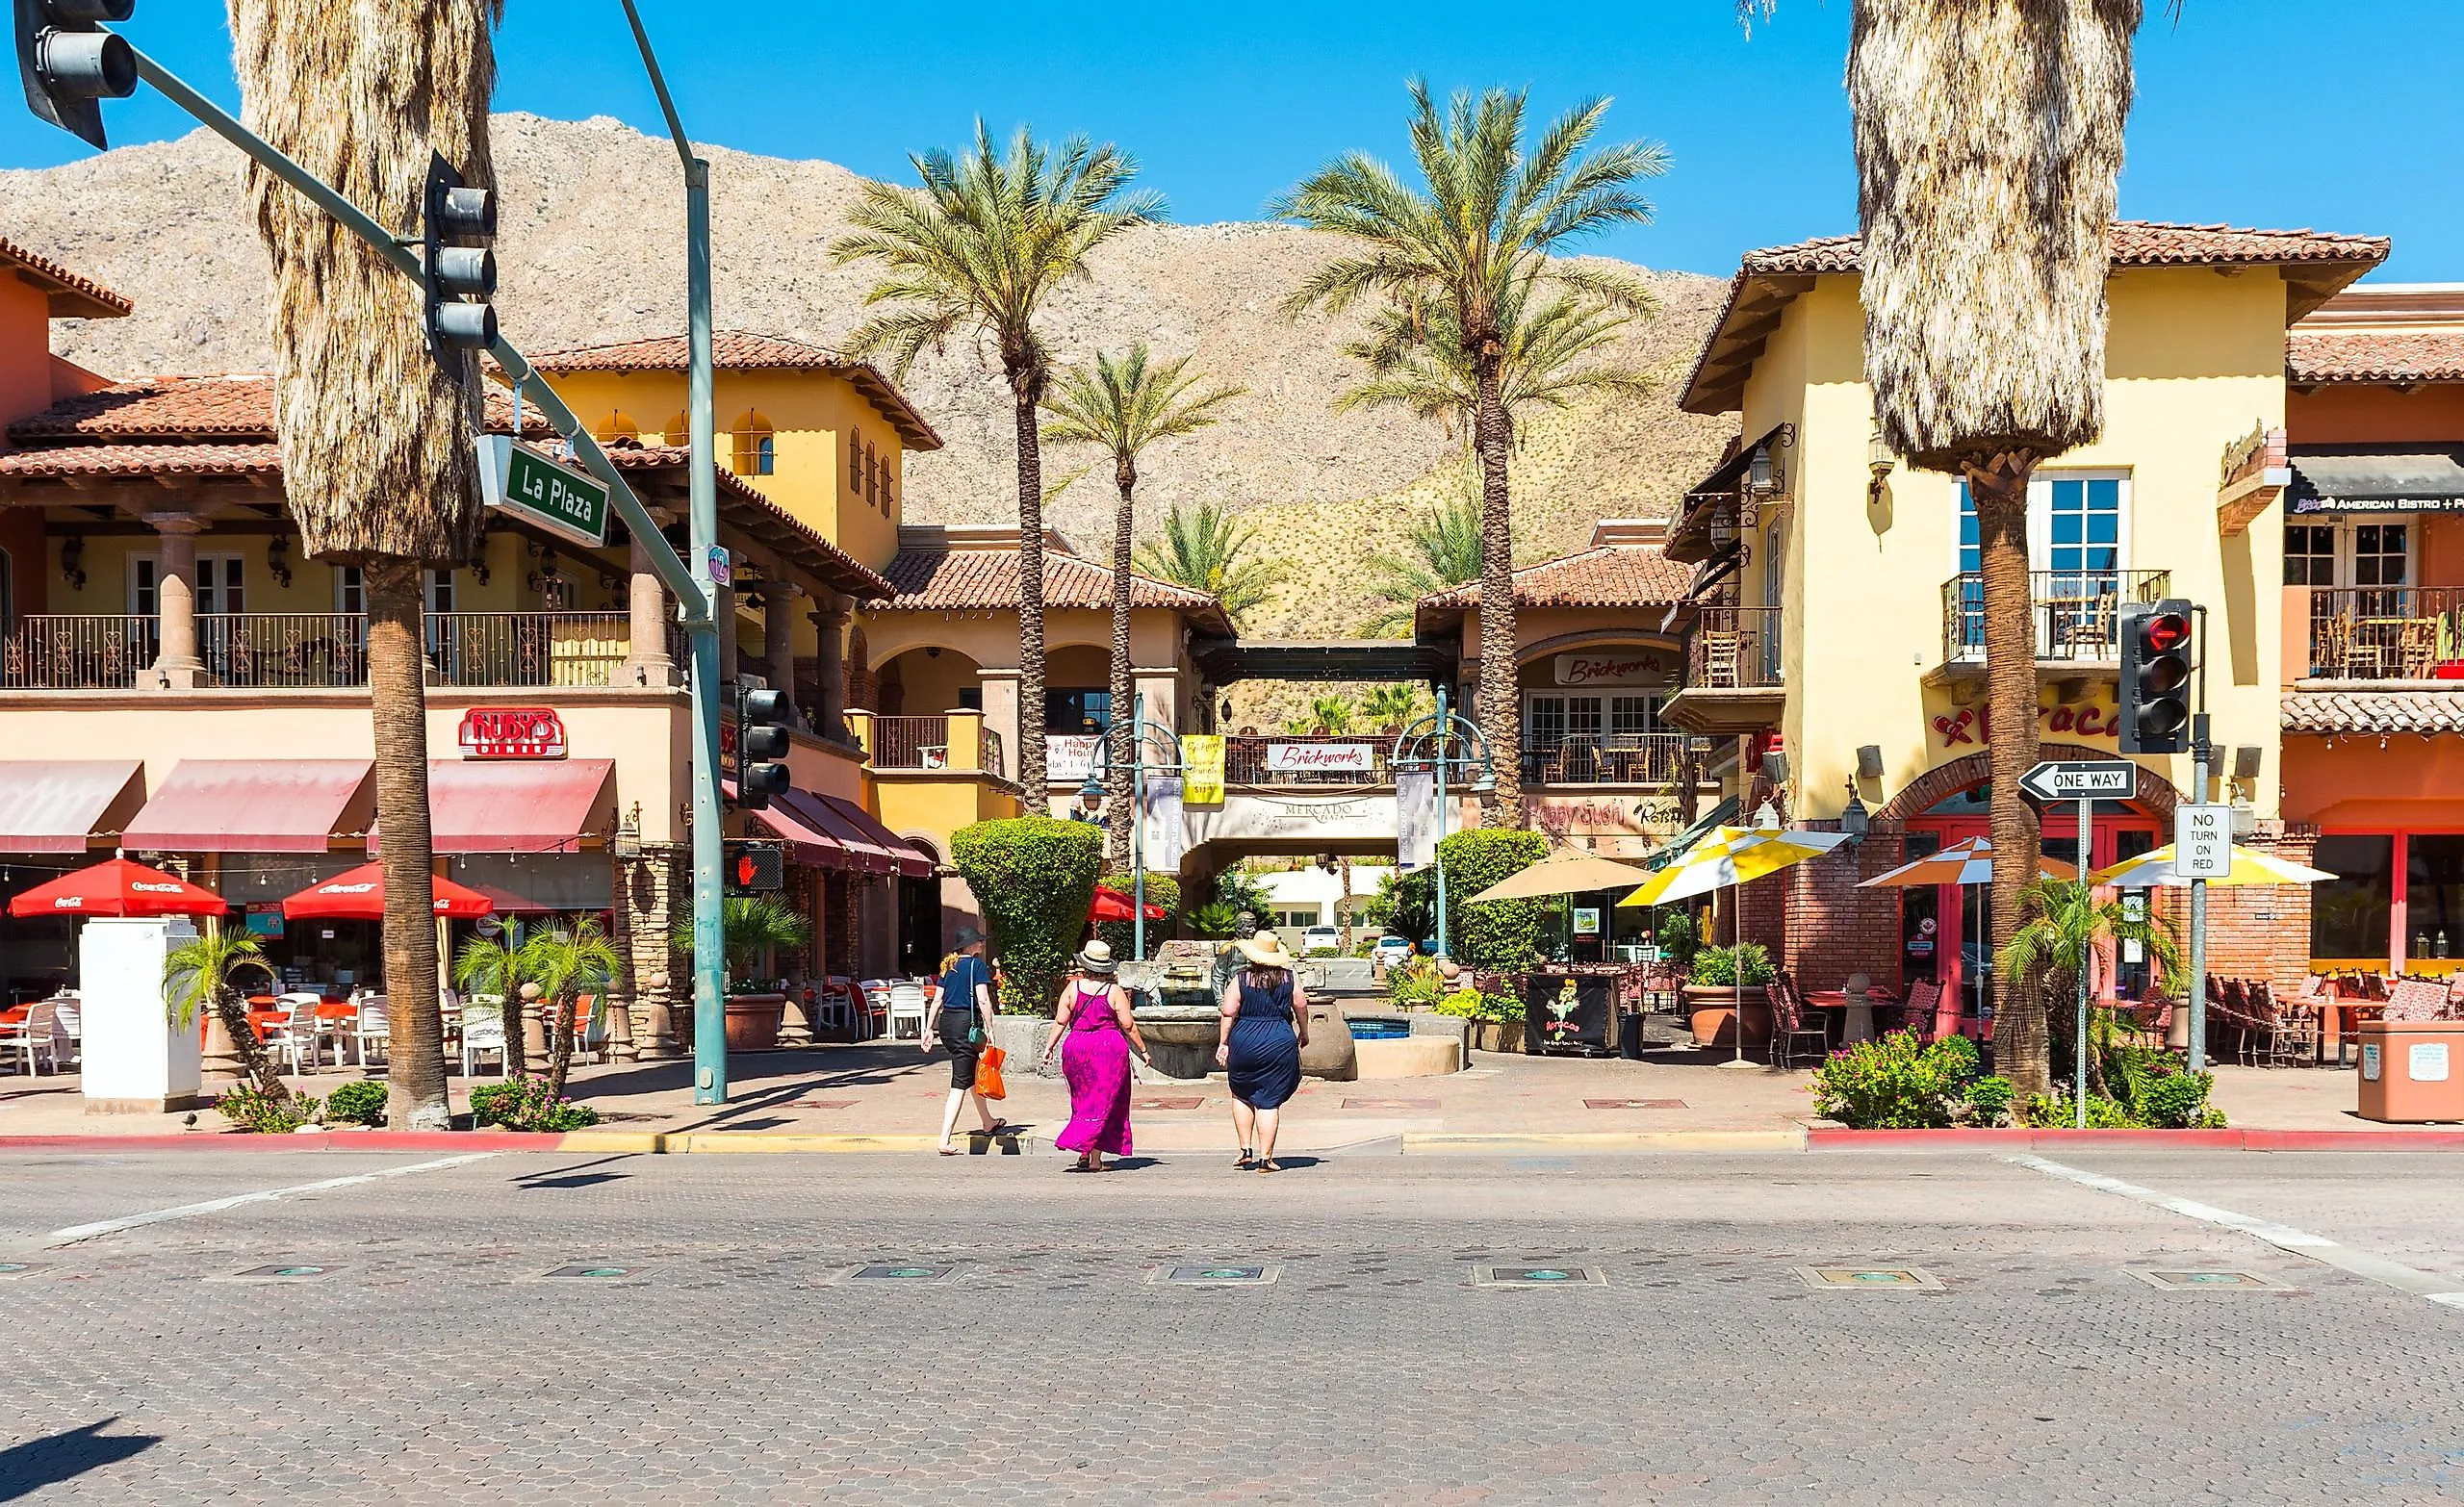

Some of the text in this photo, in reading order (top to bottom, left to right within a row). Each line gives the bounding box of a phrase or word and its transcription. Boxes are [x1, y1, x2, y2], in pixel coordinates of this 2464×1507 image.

[522, 465, 592, 523] La Plaza
[715, 552, 726, 577] 12
[1560, 654, 1660, 684] Brickworks
[481, 745, 542, 754] DINER
[1272, 746, 1363, 769] Brickworks
[2054, 773, 2122, 788] ONE WAY
[1285, 805, 1352, 816] MERCADO
[2193, 814, 2214, 827] NO
[2190, 830, 2218, 841] TURN
[2195, 845, 2211, 856] ON
[2193, 858, 2214, 870] RED
